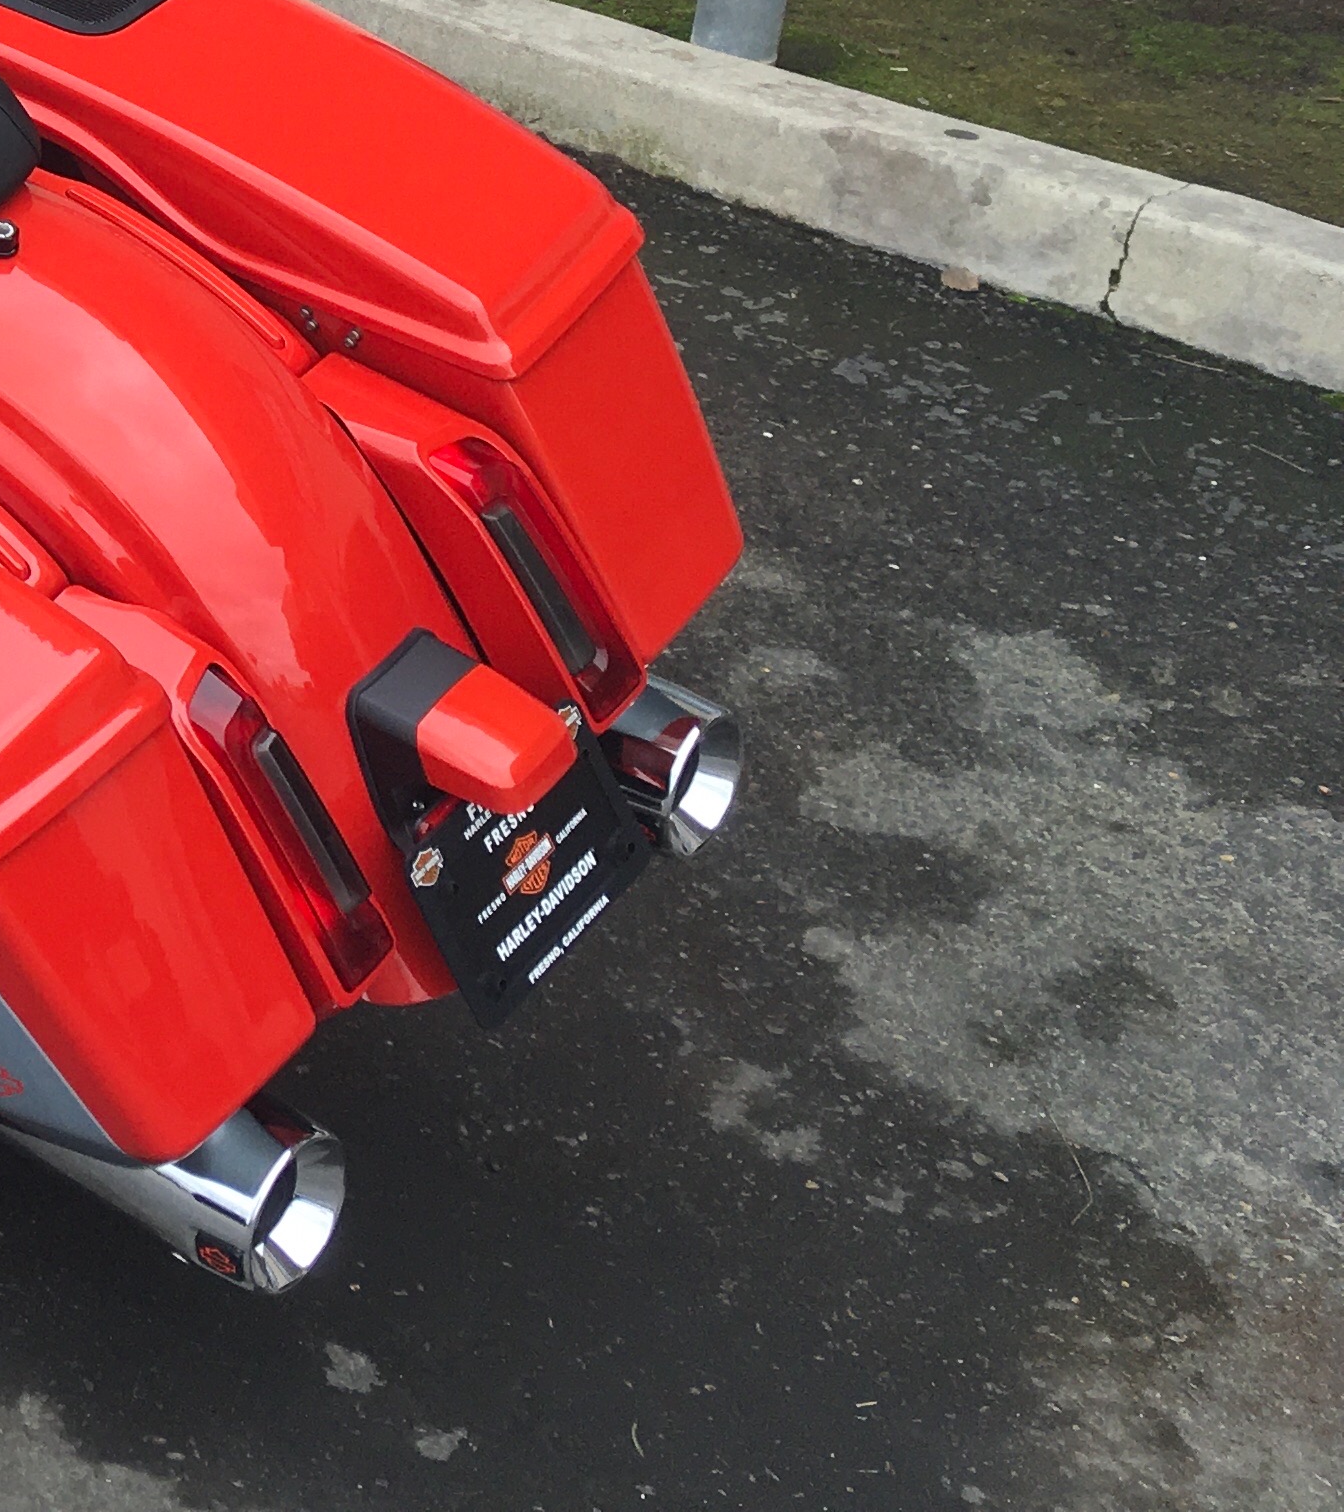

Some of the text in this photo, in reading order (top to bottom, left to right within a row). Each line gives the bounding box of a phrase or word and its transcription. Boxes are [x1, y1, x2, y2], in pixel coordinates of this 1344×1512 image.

[477, 807, 588, 924] FRESNO CALIFORNIA
[496, 850, 597, 962] HARLEY-DAVIDSON
[505, 838, 552, 889] HARLEY-DAVIDSON
[528, 893, 610, 984] FRESNO, CALIFORNIA
